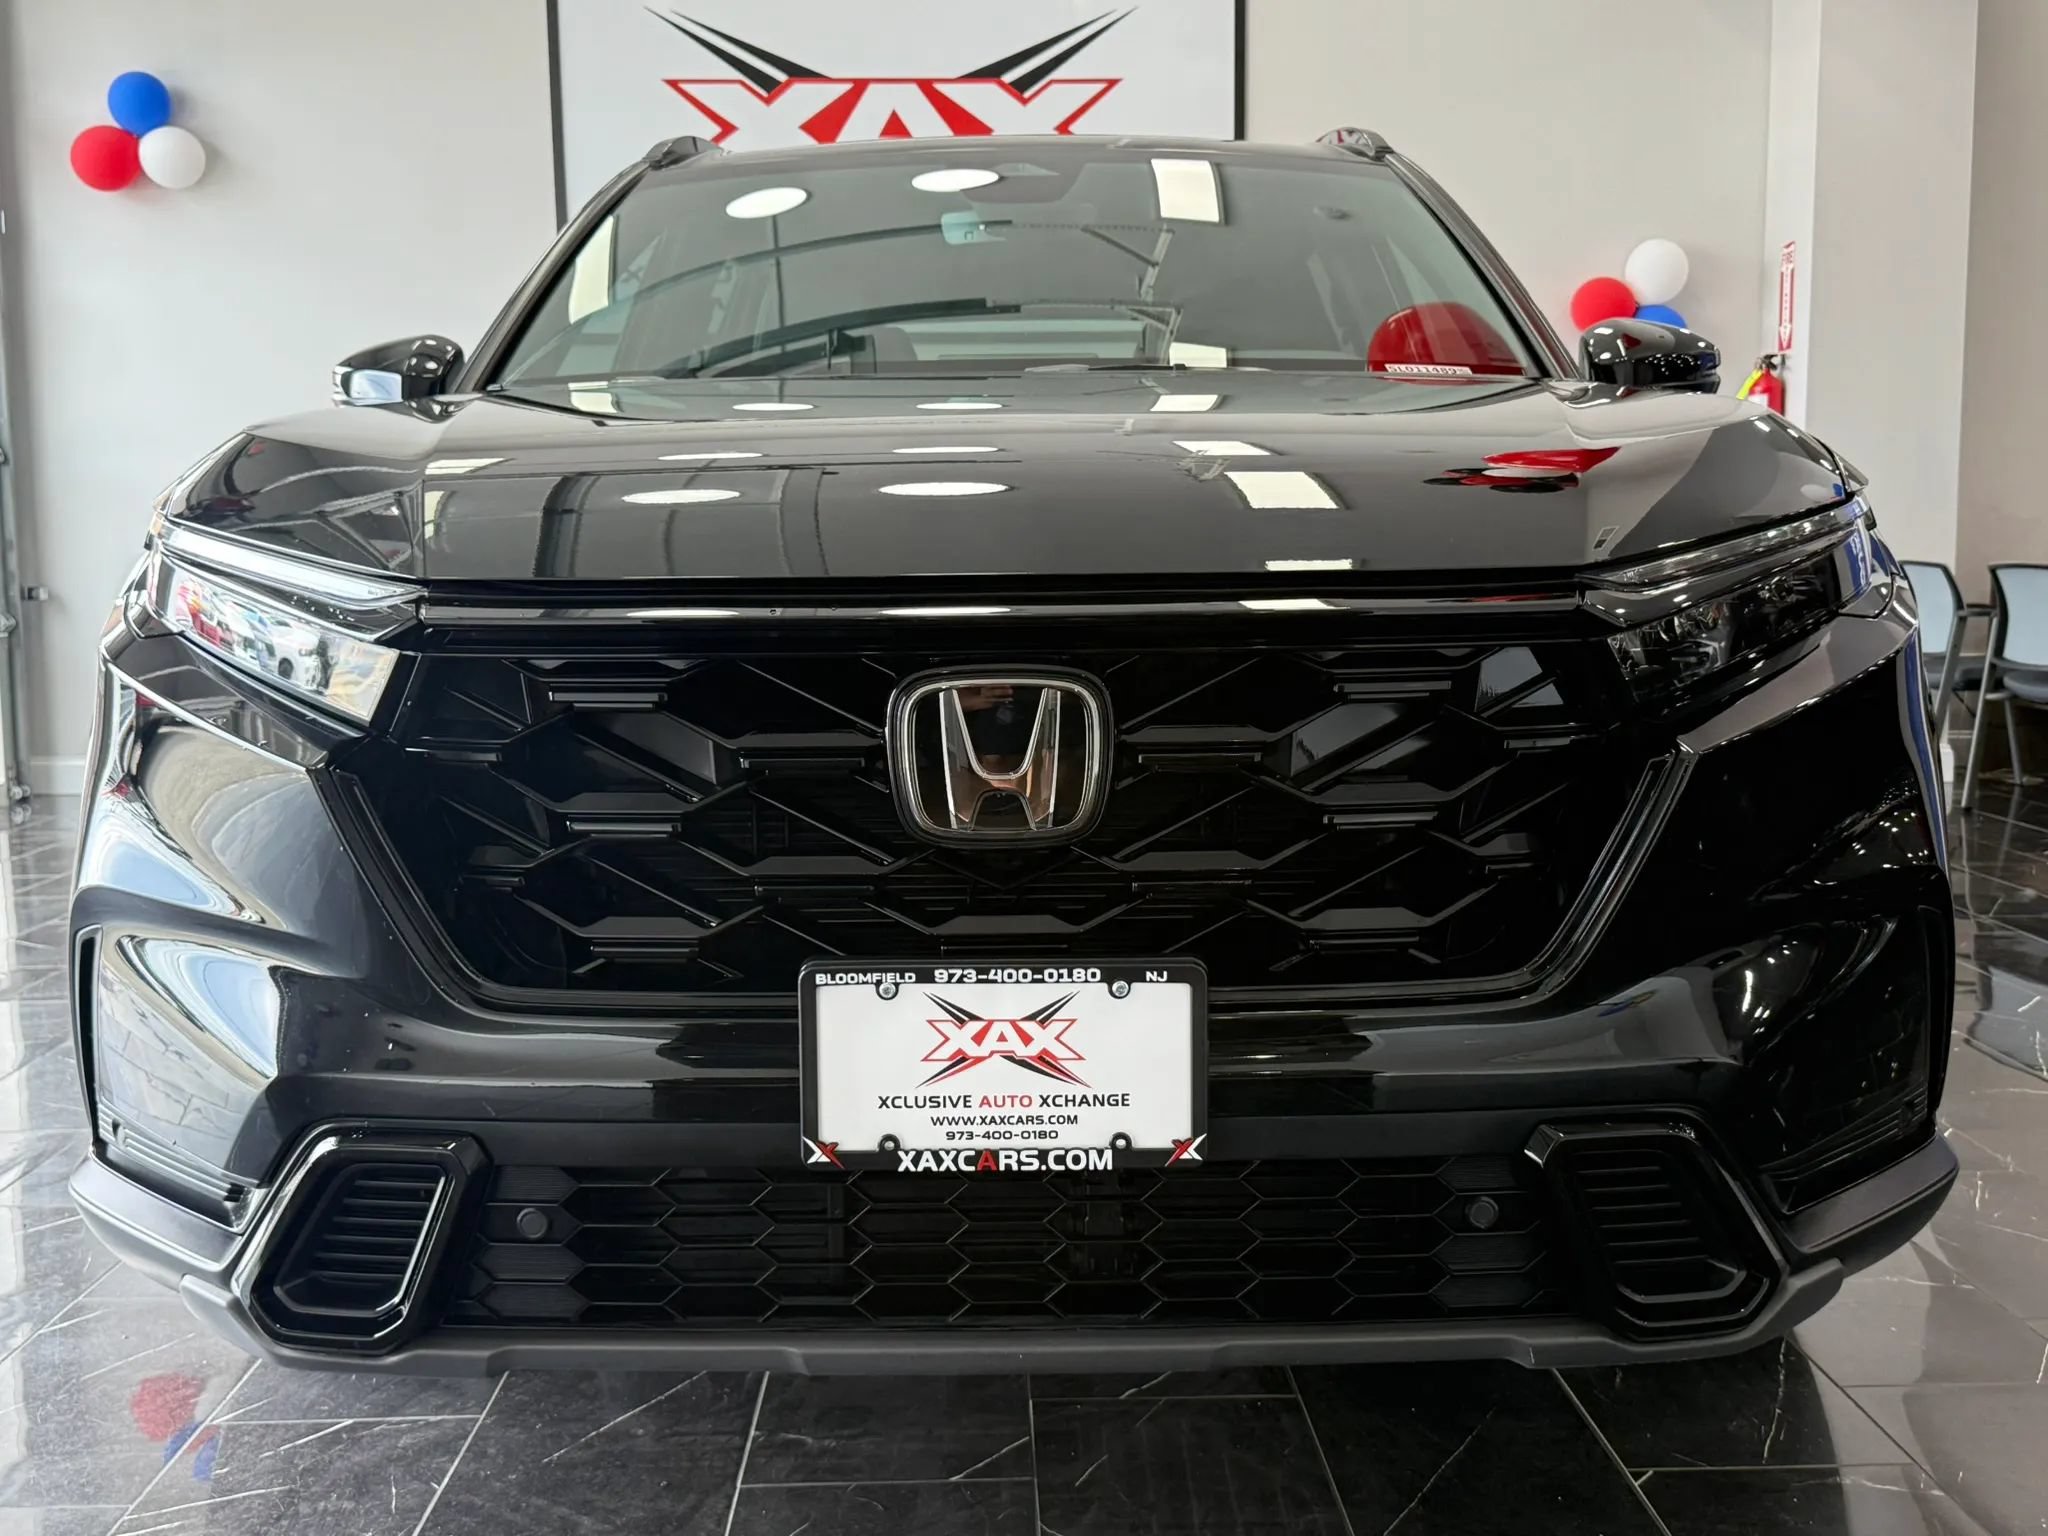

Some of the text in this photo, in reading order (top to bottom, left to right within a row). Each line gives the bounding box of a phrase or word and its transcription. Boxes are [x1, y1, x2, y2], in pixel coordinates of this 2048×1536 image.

[815, 973, 916, 985] BLOOMFIELD
[934, 968, 1101, 984] 973-400-0180
[1145, 970, 1168, 982] NJ
[920, 1018, 1086, 1062] XAX
[878, 1093, 1130, 1109] XCLUSIVE AUTO XCHANGE
[930, 1114, 1078, 1126] WWW.XAXCARS.COM
[945, 1130, 1059, 1141] 973-400-0180
[897, 1149, 1113, 1173] XAXCARS.COM
